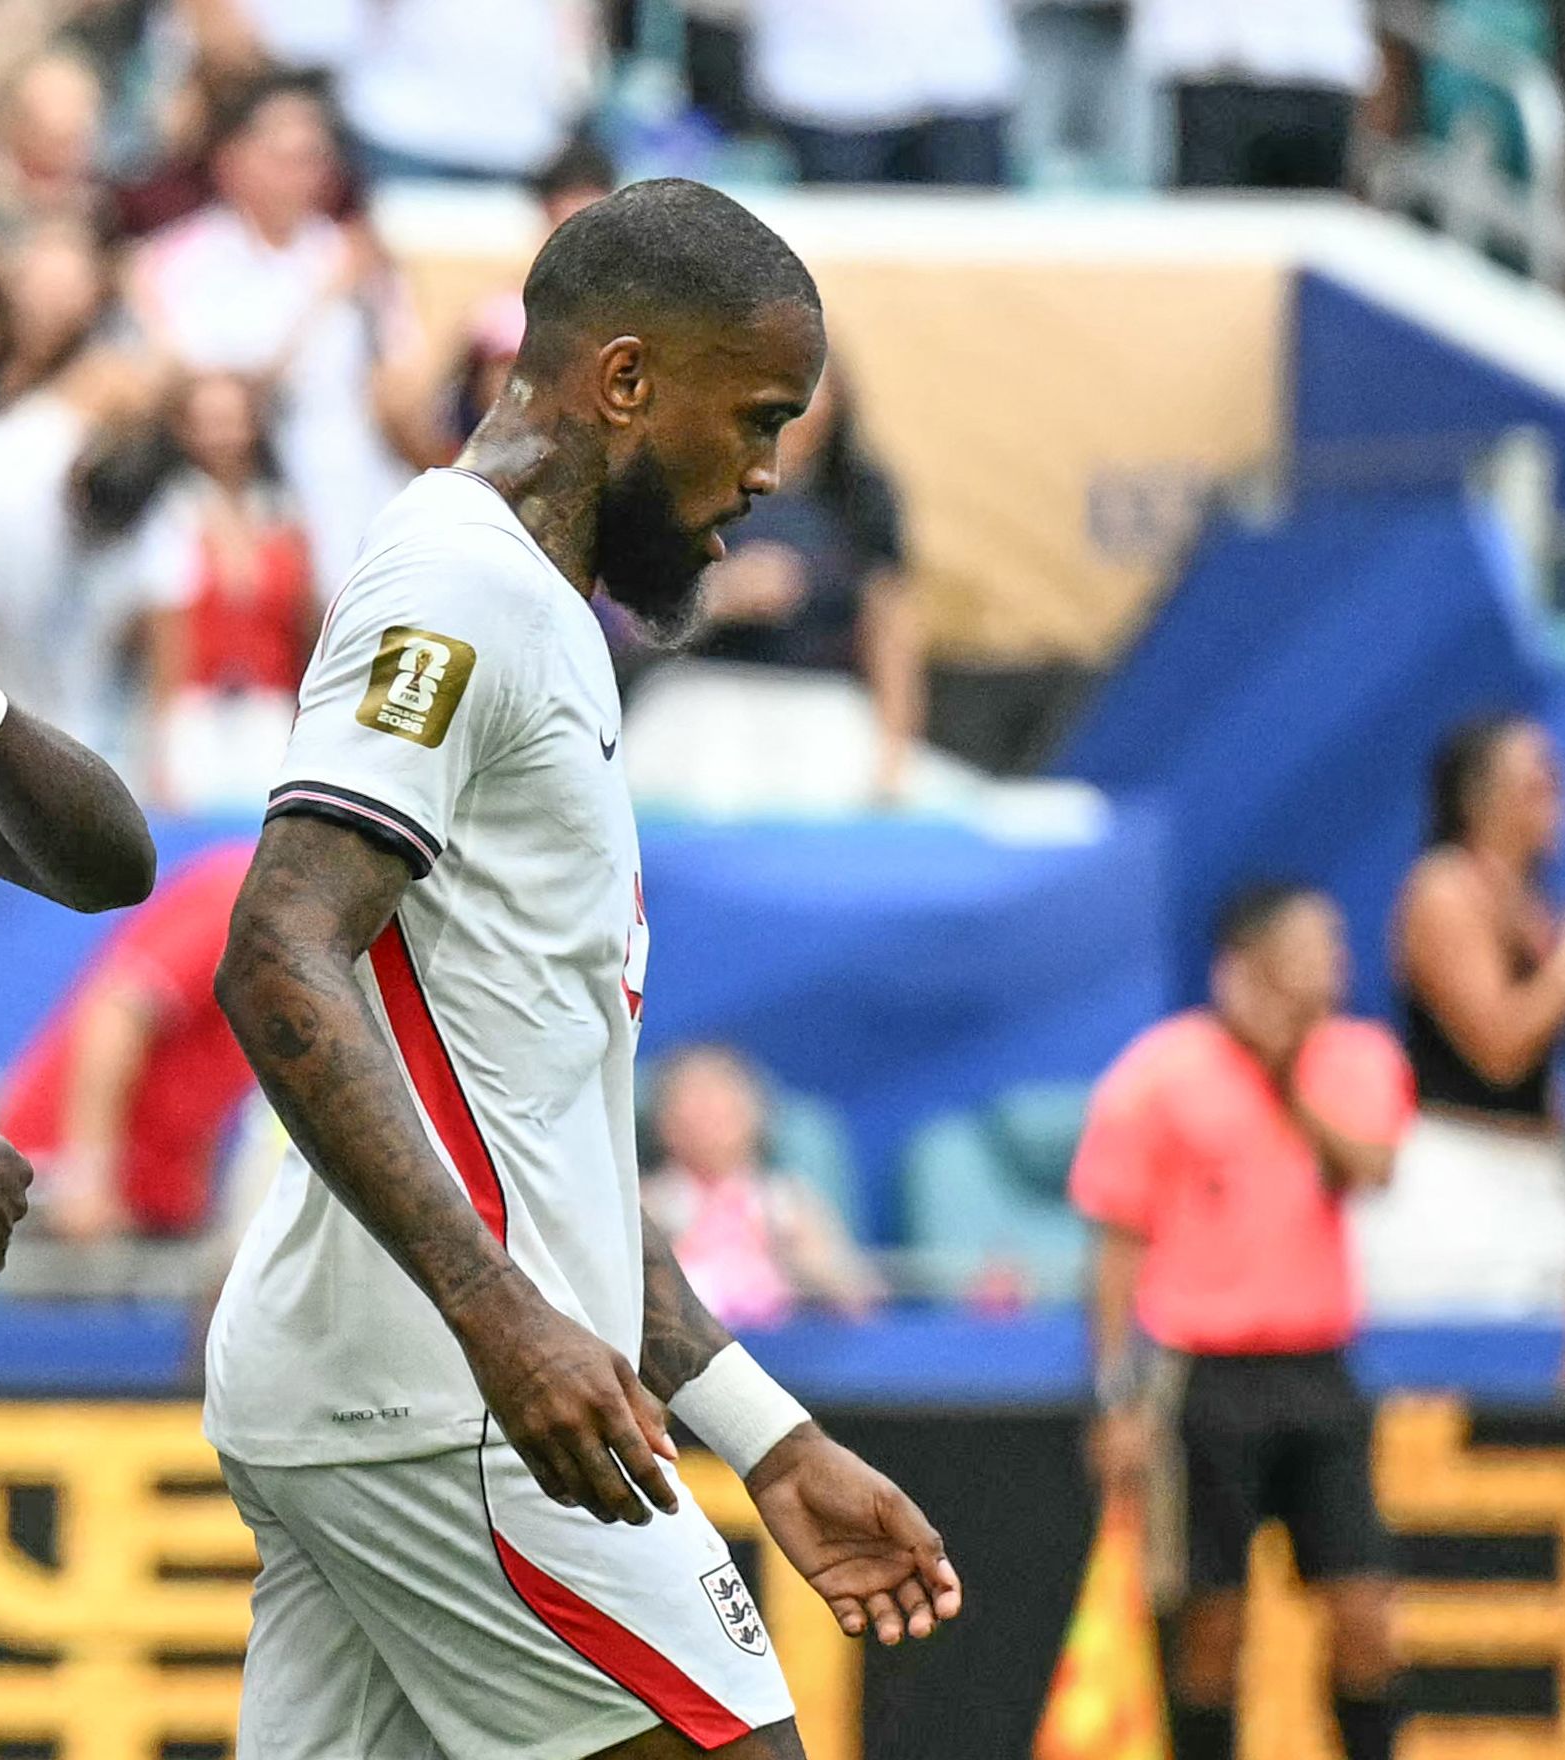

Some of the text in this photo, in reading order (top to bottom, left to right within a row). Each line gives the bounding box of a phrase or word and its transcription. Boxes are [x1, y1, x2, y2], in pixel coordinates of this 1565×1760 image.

[399, 691, 420, 704] FIFA
[377, 711, 424, 735] 2026
[332, 1407, 411, 1422] AERO-FIT
